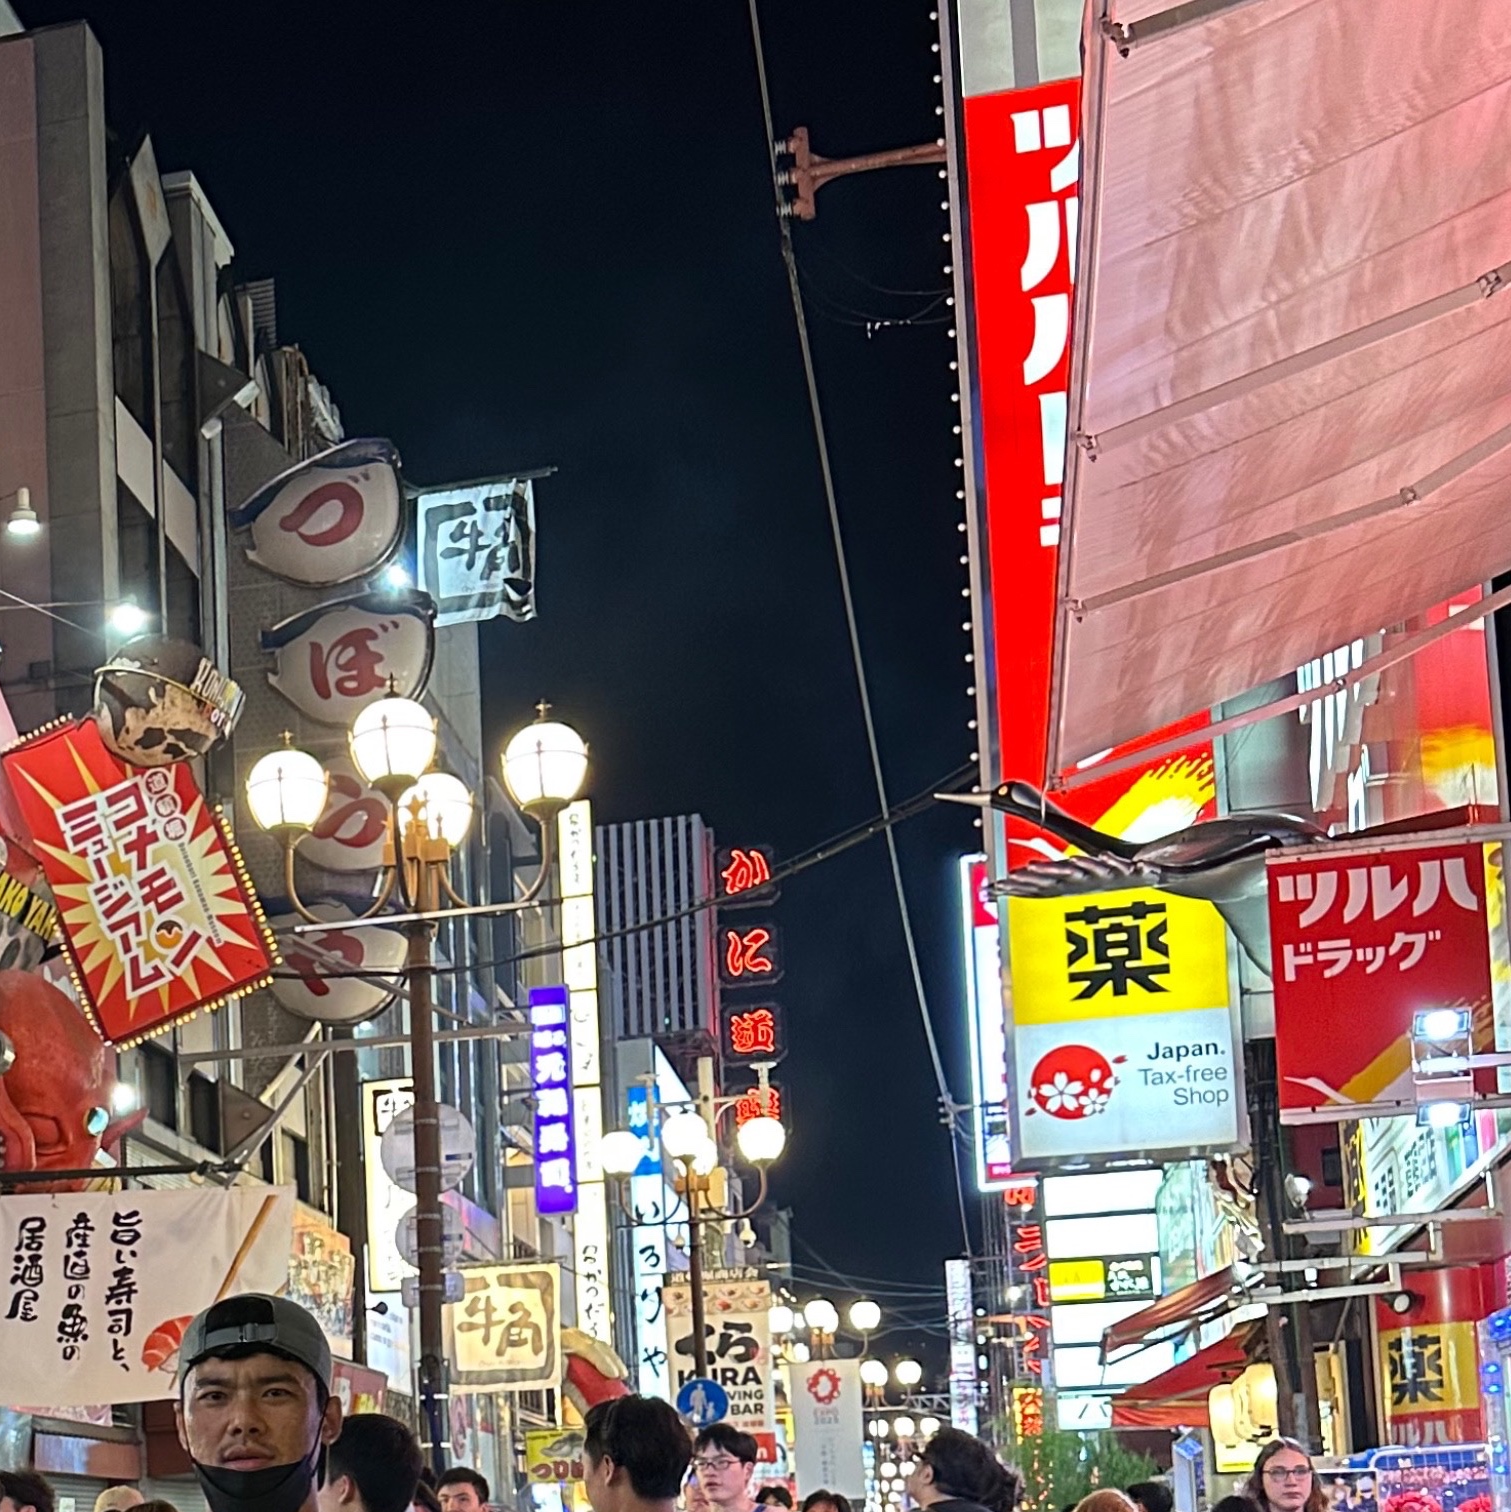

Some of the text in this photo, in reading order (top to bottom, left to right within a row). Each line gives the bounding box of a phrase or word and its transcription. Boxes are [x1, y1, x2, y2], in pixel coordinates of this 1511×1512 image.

[23, 895, 61, 942] YAK
[61, 799, 168, 994] ミュージアム
[1276, 856, 1480, 930] ツルハ
[1064, 900, 1171, 1003] 薬
[1281, 929, 1442, 982] ドラッグ
[1137, 1063, 1228, 1087] Tax-free
[1146, 1041, 1226, 1063] Japan.
[1173, 1085, 1231, 1110] Shop
[4, 1215, 47, 1323] 居酒屋
[56, 1211, 96, 1363] 産直の魚の
[104, 1209, 144, 1373] 旨い寿司と、
[634, 1200, 668, 1379] いろりや
[456, 1294, 545, 1358] 牛角
[674, 1320, 761, 1367] くら
[1387, 1333, 1446, 1407] 薬
[730, 1403, 765, 1416] BAR
